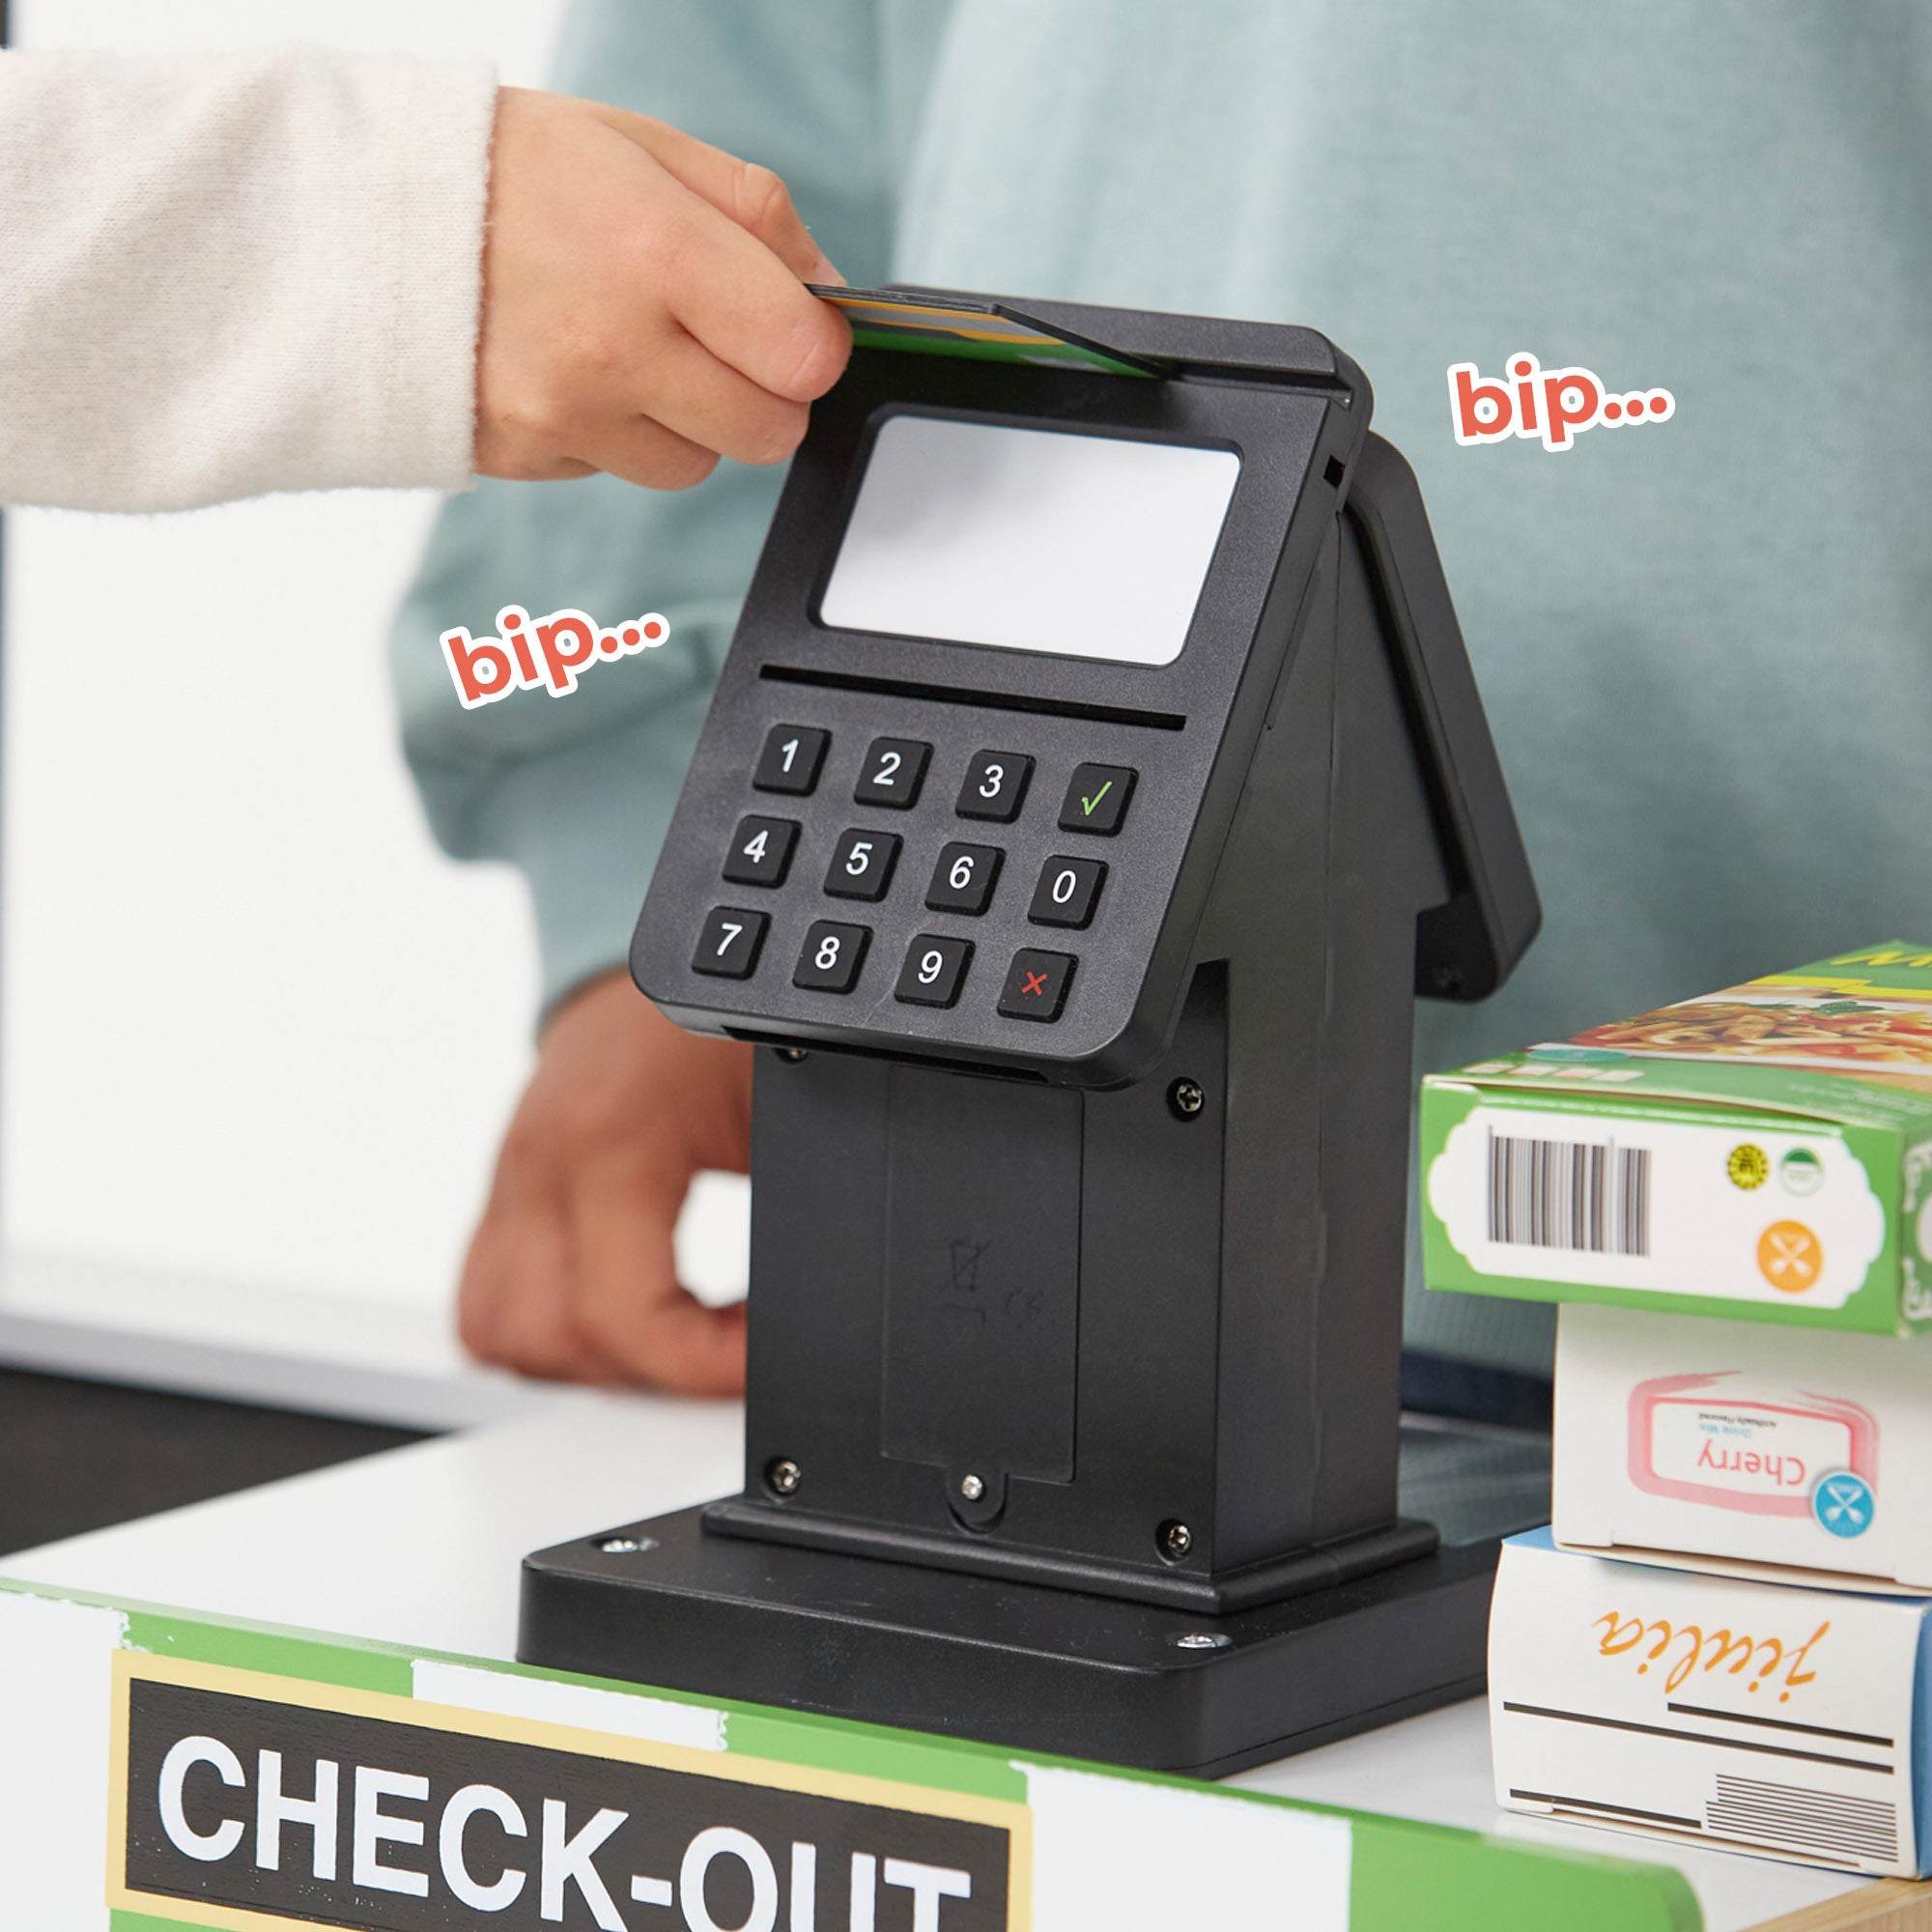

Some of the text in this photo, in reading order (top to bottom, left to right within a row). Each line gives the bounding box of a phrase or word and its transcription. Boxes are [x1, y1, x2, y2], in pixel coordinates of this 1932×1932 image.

[781, 739, 1004, 798] 1 2 3
[743, 830, 1076, 904] 4 5 6 0
[717, 923, 943, 984] 7 8 9
[1697, 1438, 1805, 1486] Cherry
[158, 1735, 971, 1932] CHECK-OUT
